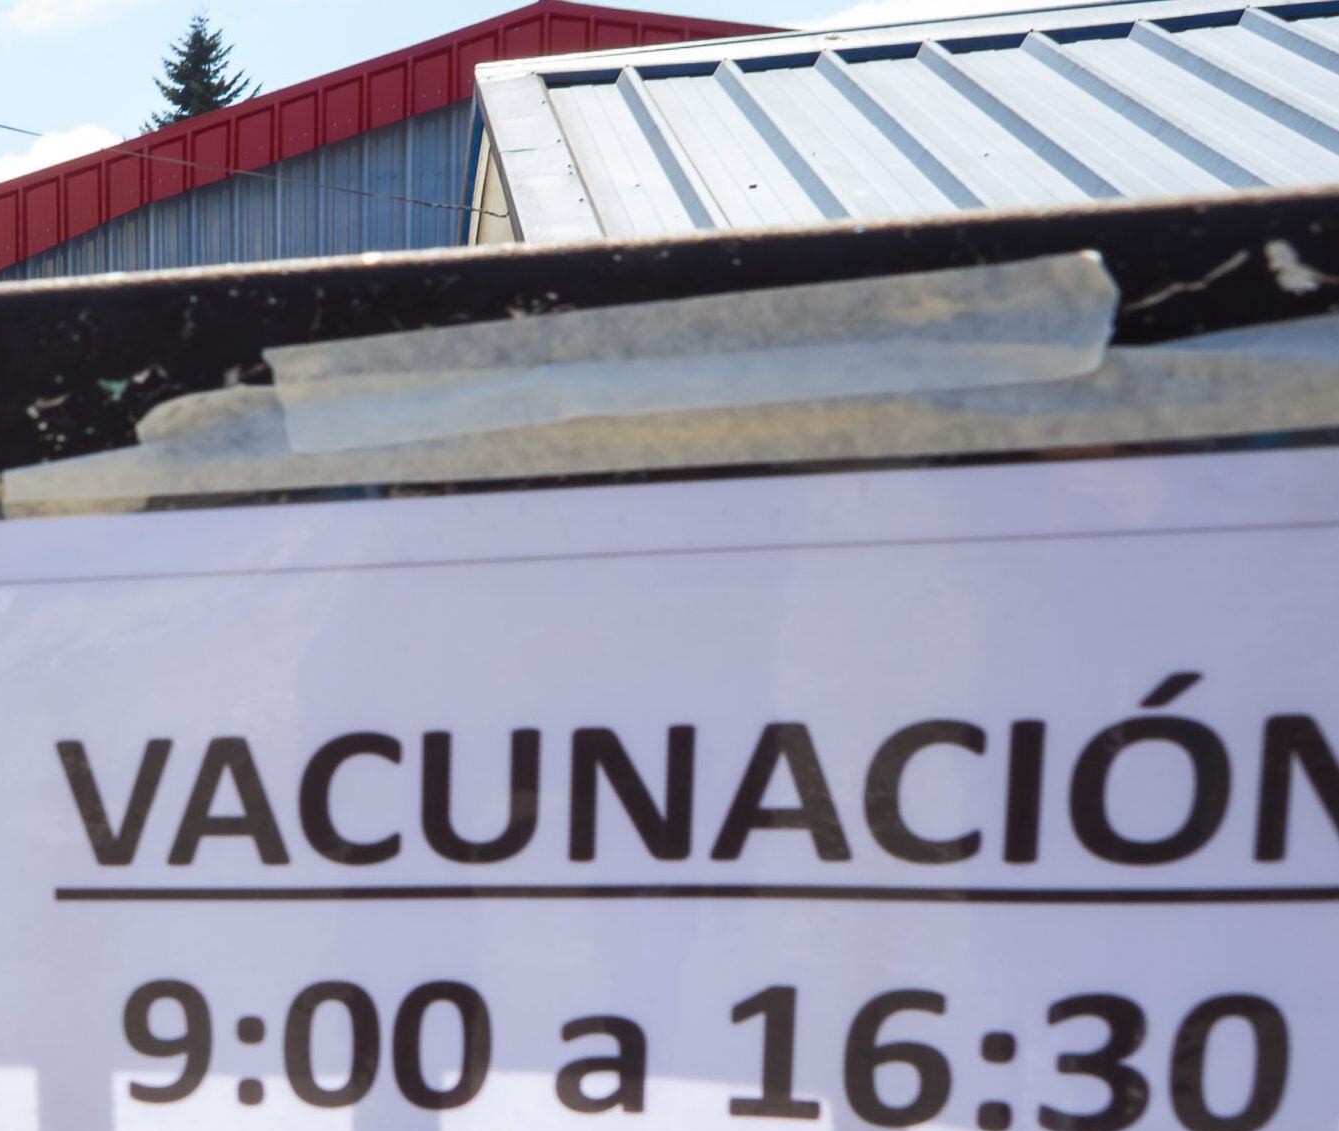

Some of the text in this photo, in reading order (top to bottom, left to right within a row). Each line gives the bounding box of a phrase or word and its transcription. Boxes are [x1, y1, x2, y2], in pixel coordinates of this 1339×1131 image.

[54, 668, 1339, 868] VACUNACIÓN
[121, 977, 494, 1113] 9:00
[554, 1012, 650, 1115] a
